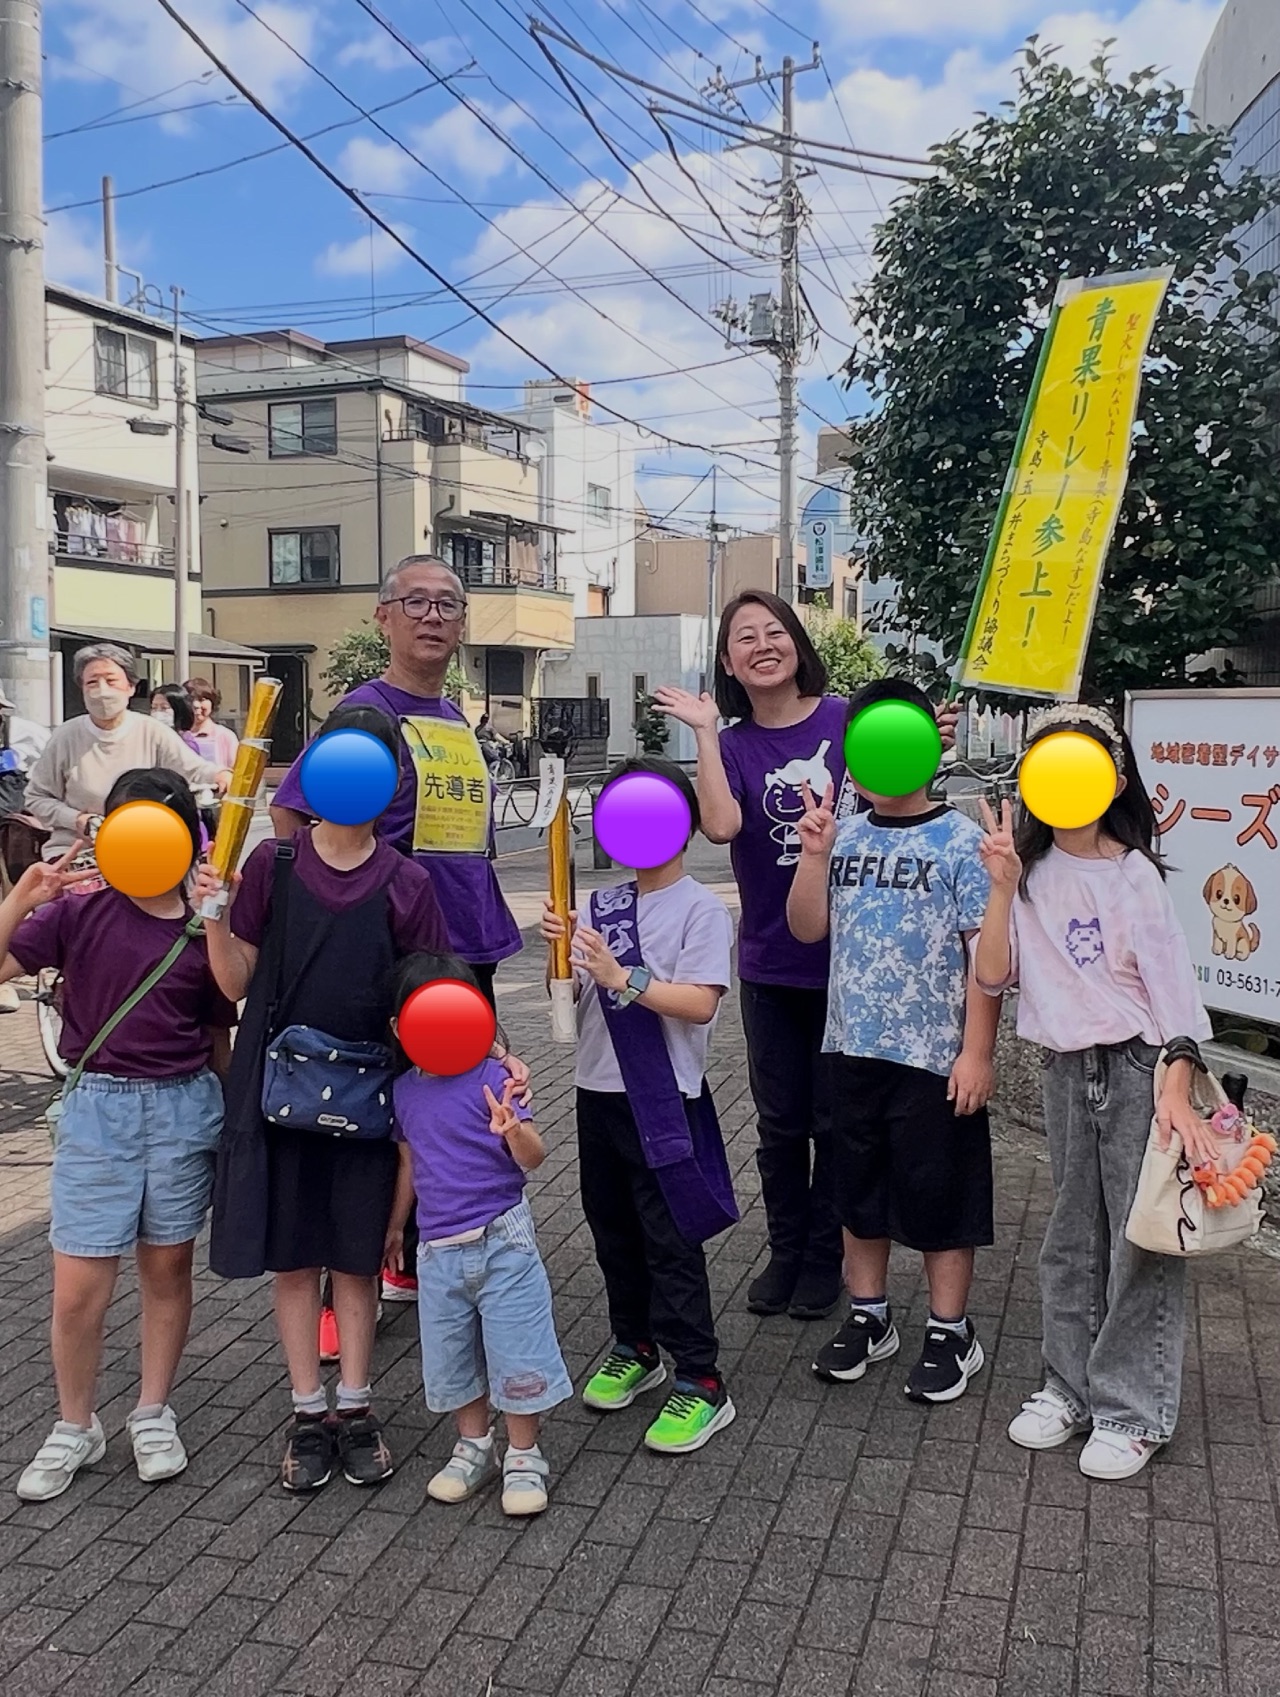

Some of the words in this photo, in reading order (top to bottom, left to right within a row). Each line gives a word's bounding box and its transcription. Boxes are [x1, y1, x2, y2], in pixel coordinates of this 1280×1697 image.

[425, 772, 485, 803] 先導者
[829, 855, 935, 893] REFLEX
